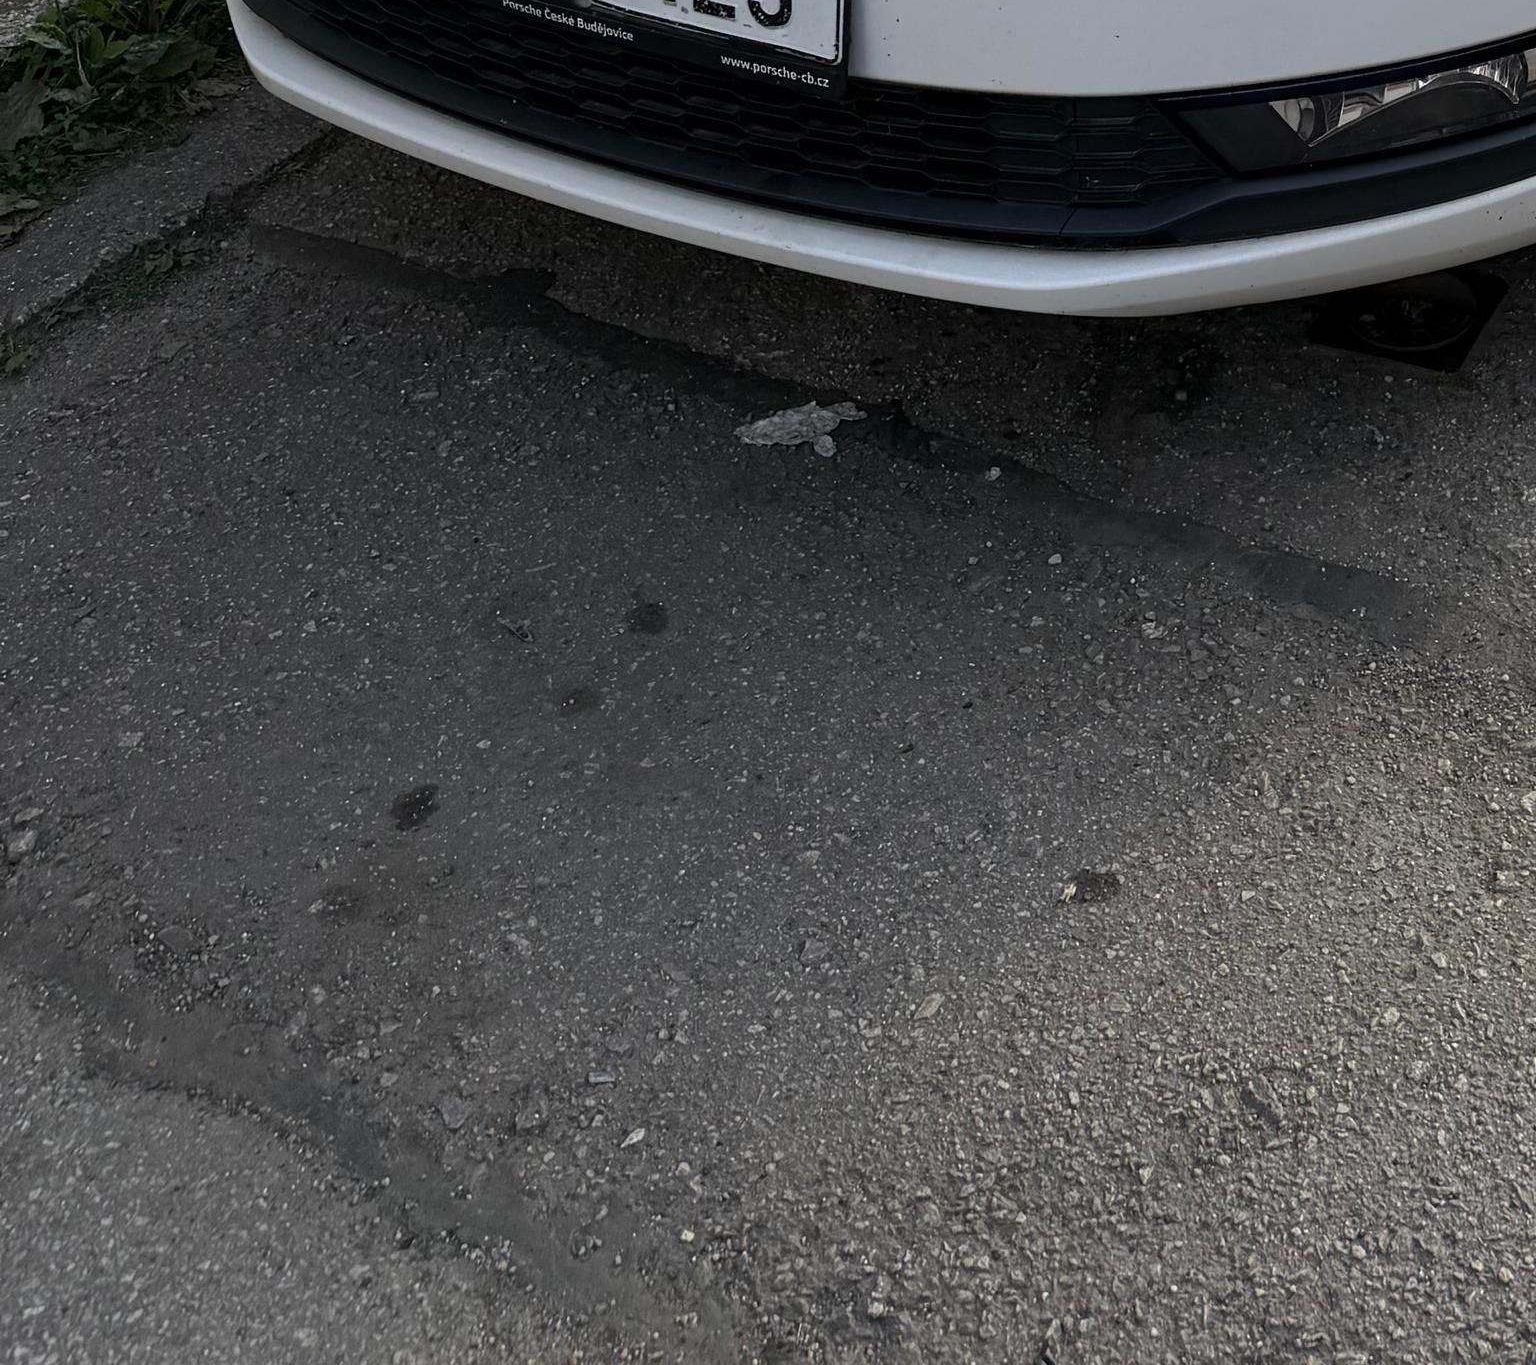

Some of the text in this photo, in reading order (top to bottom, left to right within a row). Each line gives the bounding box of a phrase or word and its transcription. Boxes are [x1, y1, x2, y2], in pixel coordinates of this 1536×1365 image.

[544, 7, 575, 27] České
[576, 17, 634, 41] Budějovice
[720, 55, 829, 88] www.porsche-cb.cz
